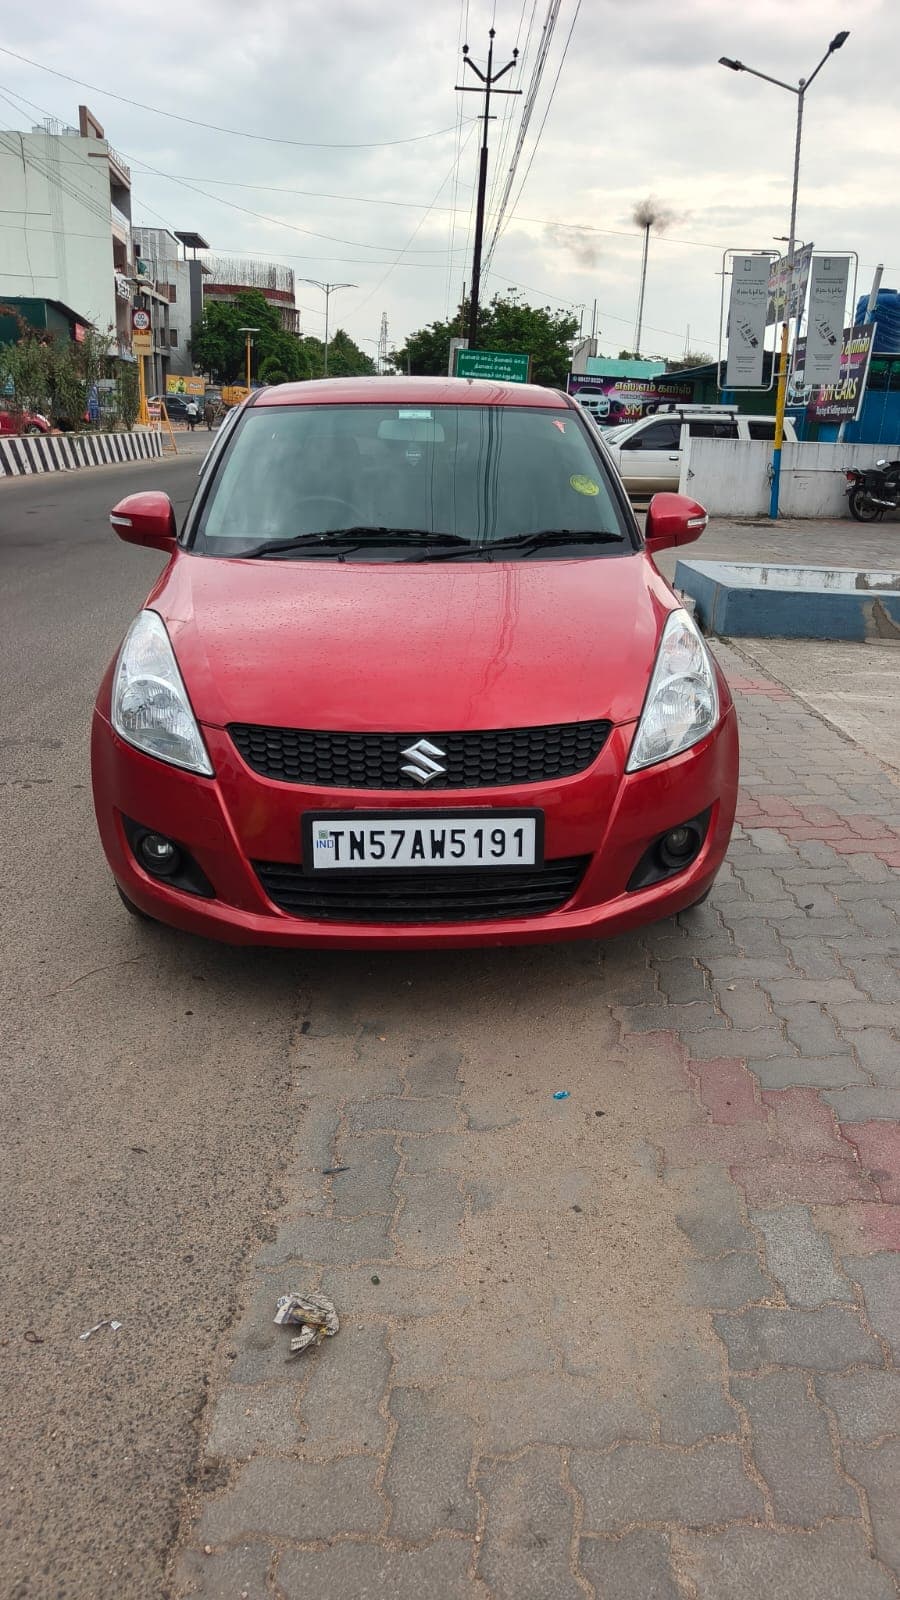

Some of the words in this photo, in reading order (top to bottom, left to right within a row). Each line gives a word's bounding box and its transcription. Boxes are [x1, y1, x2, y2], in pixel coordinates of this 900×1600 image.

[834, 376, 859, 401] CARS
[624, 402, 643, 416] SM
[316, 839, 334, 849] IND
[329, 827, 524, 861] TN57AW5191
